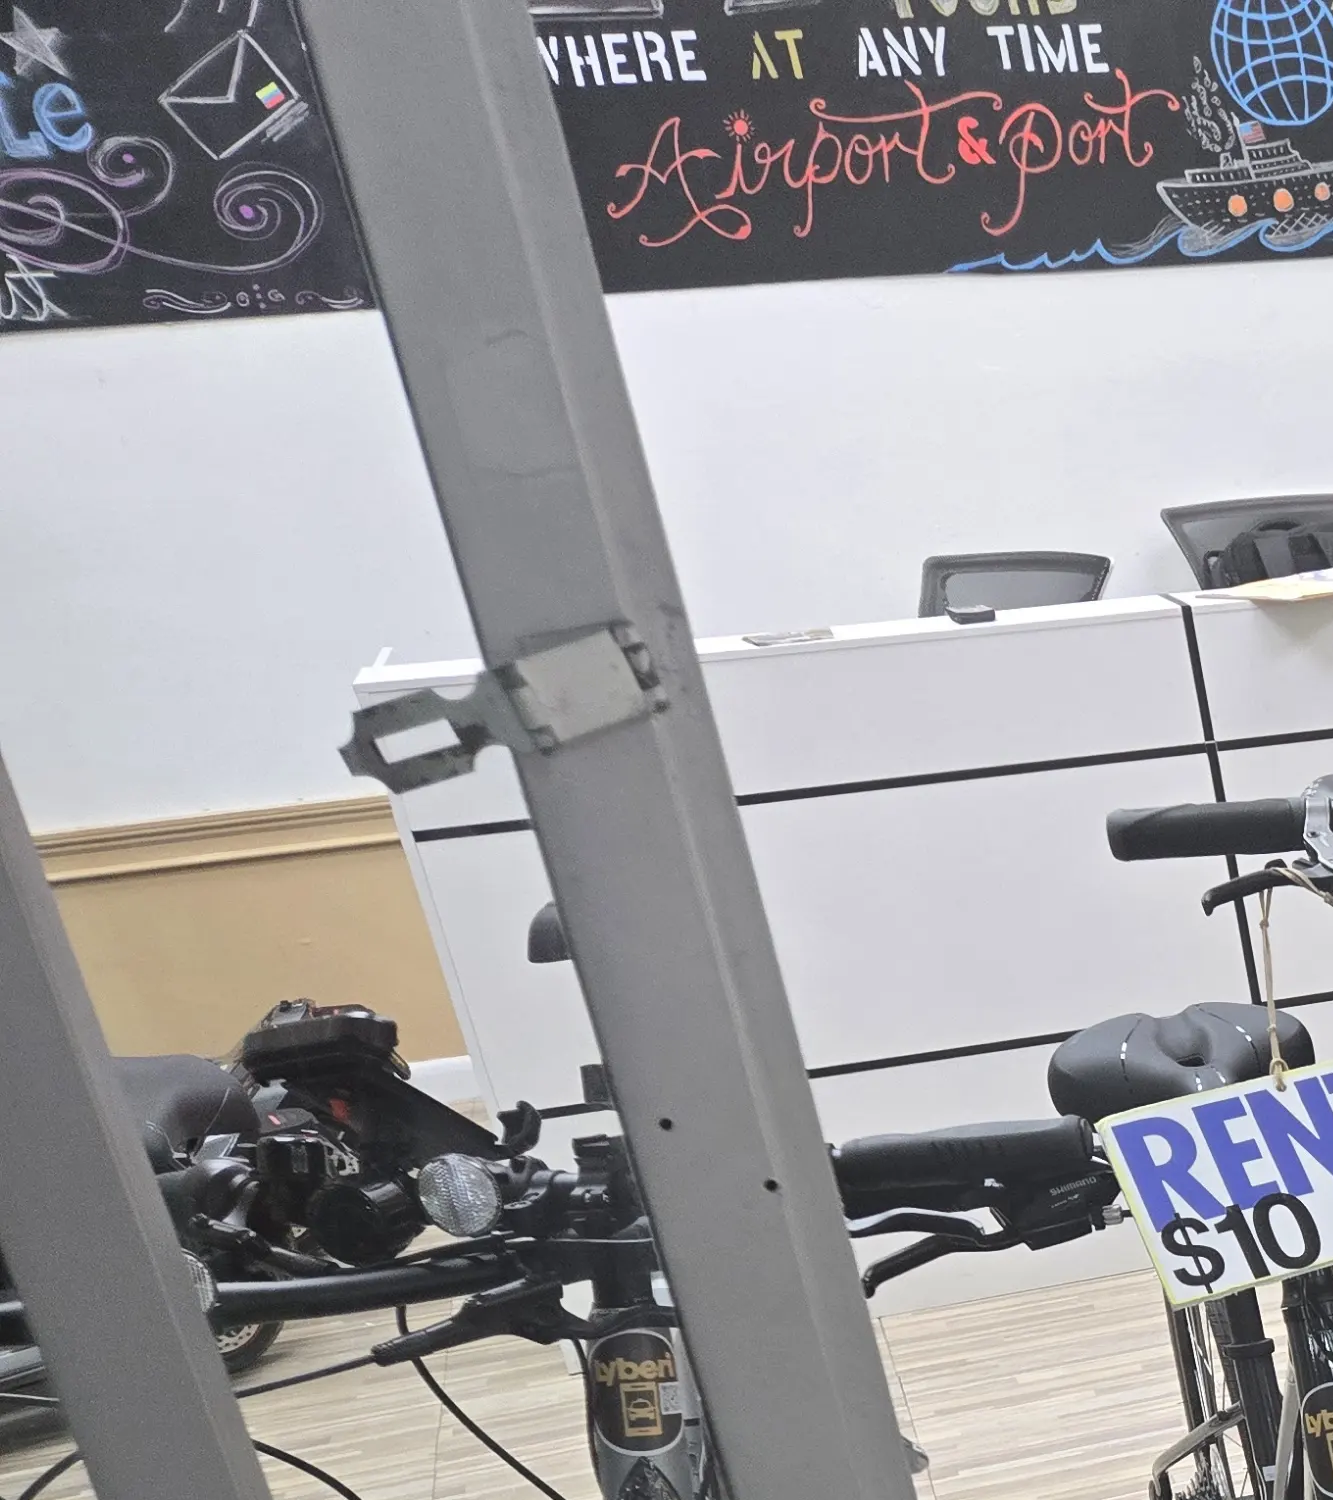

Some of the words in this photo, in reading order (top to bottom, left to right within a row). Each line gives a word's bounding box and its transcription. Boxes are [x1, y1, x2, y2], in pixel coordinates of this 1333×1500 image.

[752, 29, 803, 80] AT
[857, 25, 946, 78] ANY
[985, 23, 1110, 74] TIME
[606, 80, 1002, 247] Airport
[1048, 1176, 1097, 1197] SHIMANO
[1160, 1193, 1321, 1293] $10
